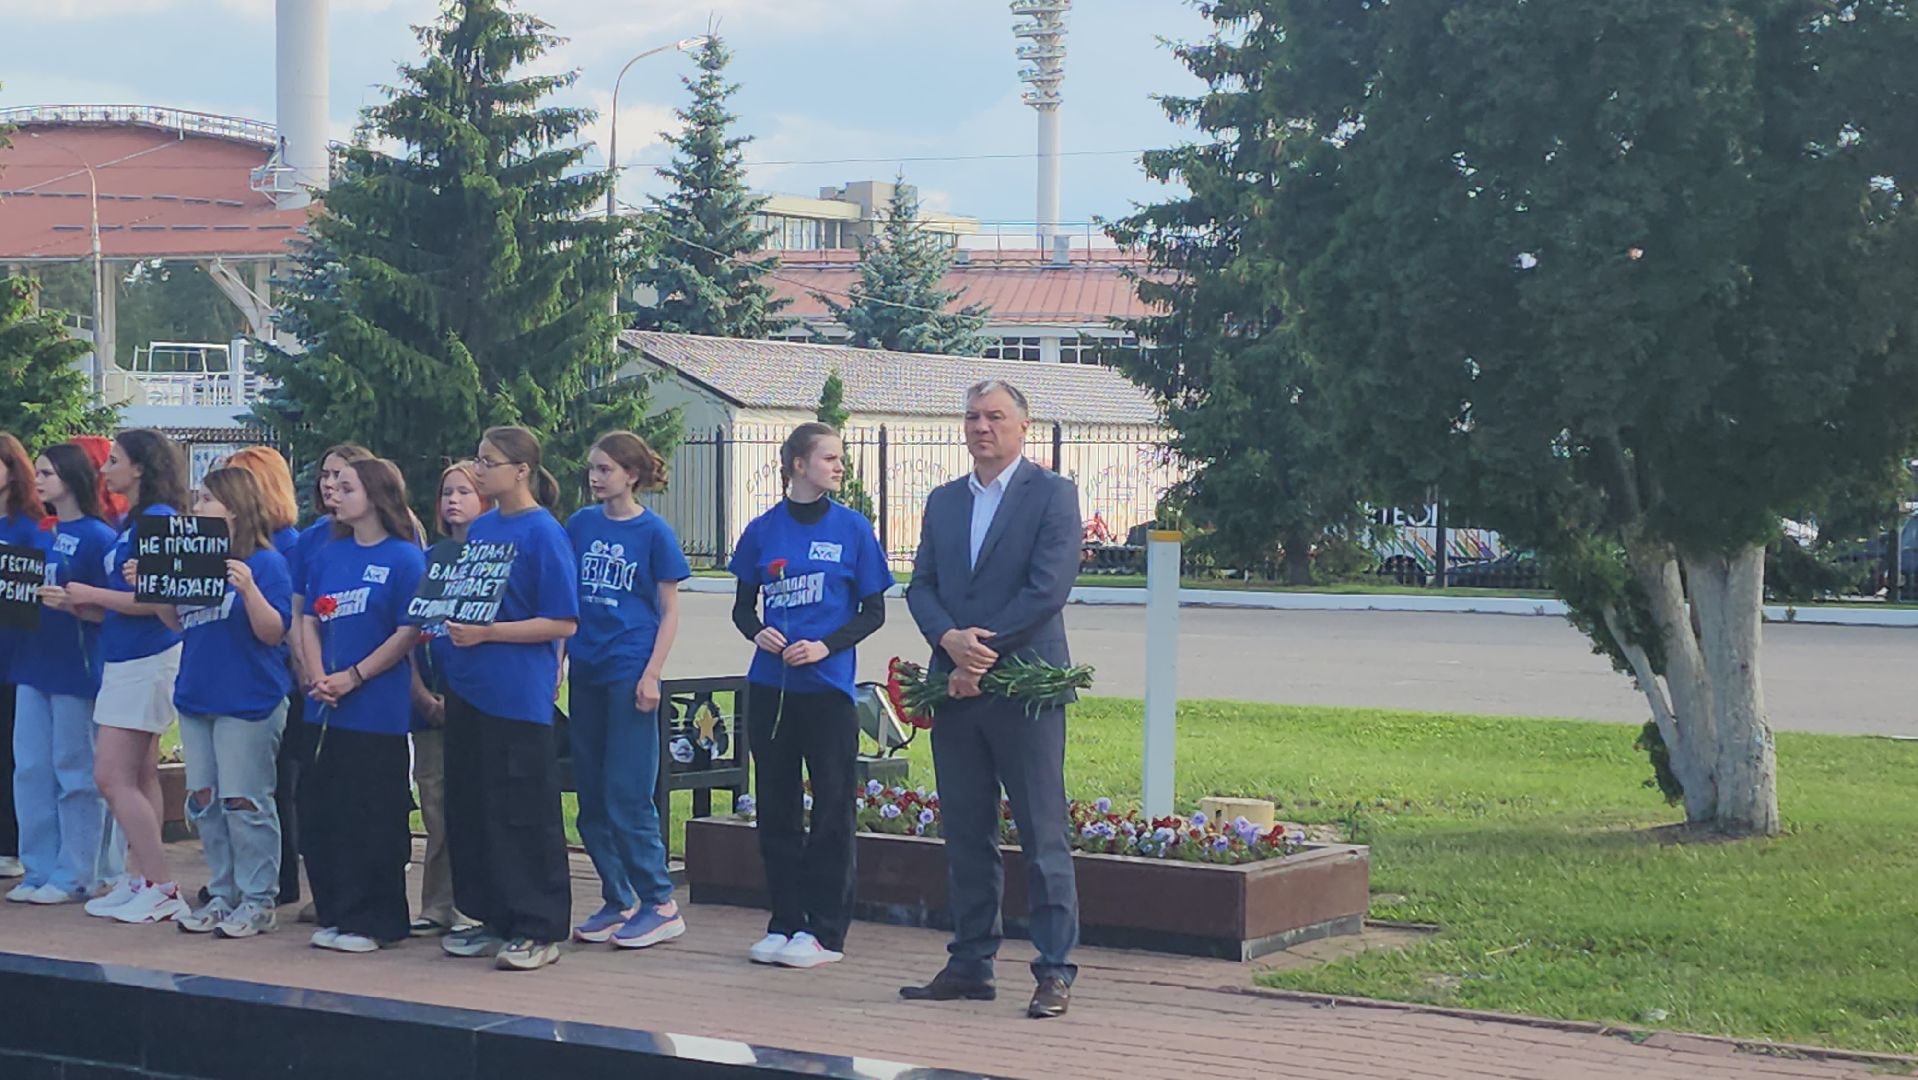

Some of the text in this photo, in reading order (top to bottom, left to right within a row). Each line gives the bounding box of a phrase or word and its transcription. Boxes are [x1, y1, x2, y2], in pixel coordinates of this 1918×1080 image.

[169, 516, 198, 536] МЫ
[139, 536, 229, 556] НЕ ПРОСТИМ
[173, 557, 182, 572] И
[138, 574, 224, 598] НЕ ЗАБУДЕМ
